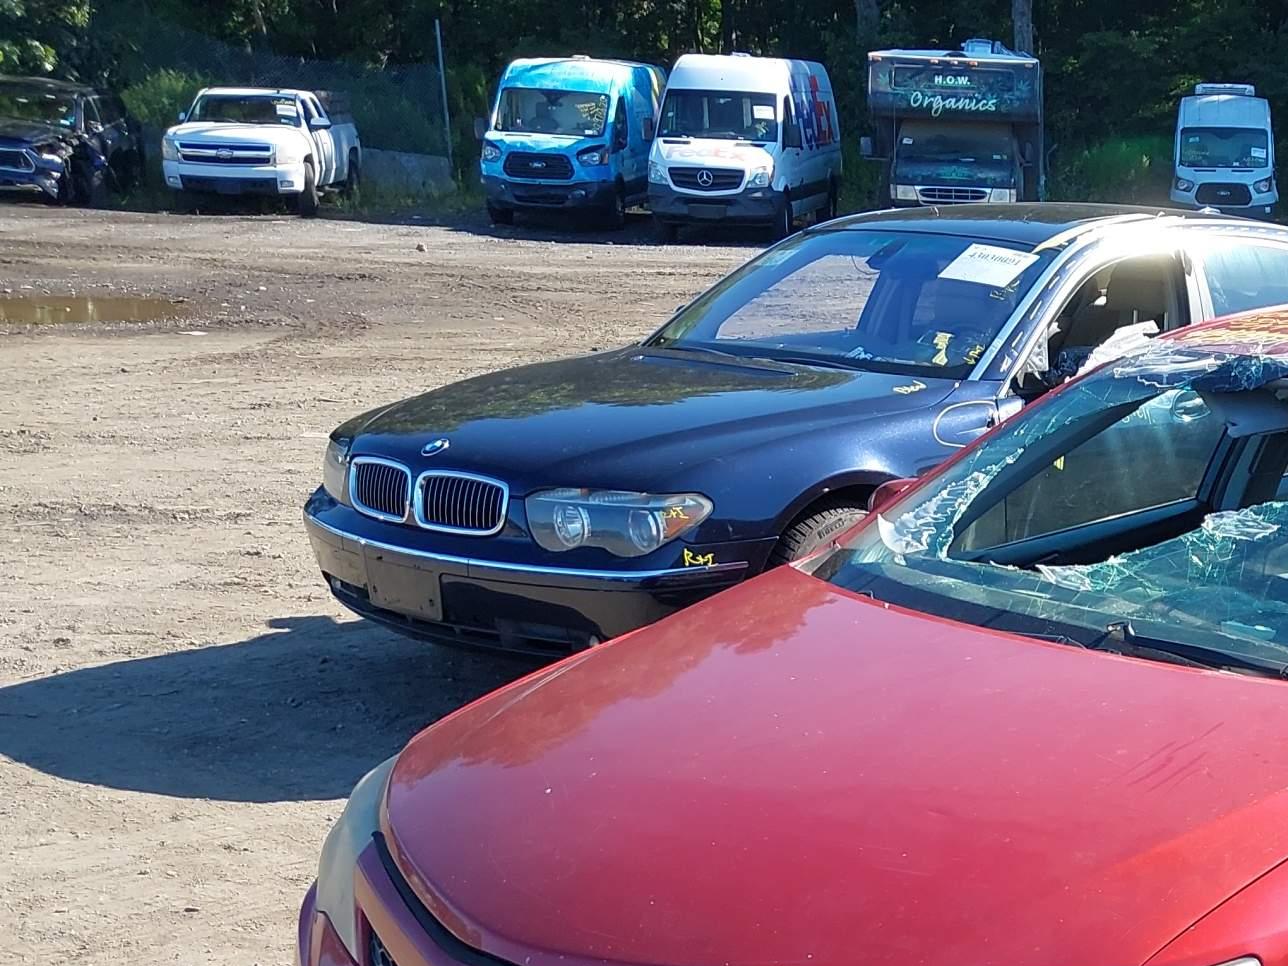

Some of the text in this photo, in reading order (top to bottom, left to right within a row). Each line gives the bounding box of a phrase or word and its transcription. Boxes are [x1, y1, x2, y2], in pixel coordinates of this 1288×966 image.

[934, 75, 971, 85] H.O.W.
[910, 91, 997, 117] Organics
[666, 146, 746, 162] FedEx
